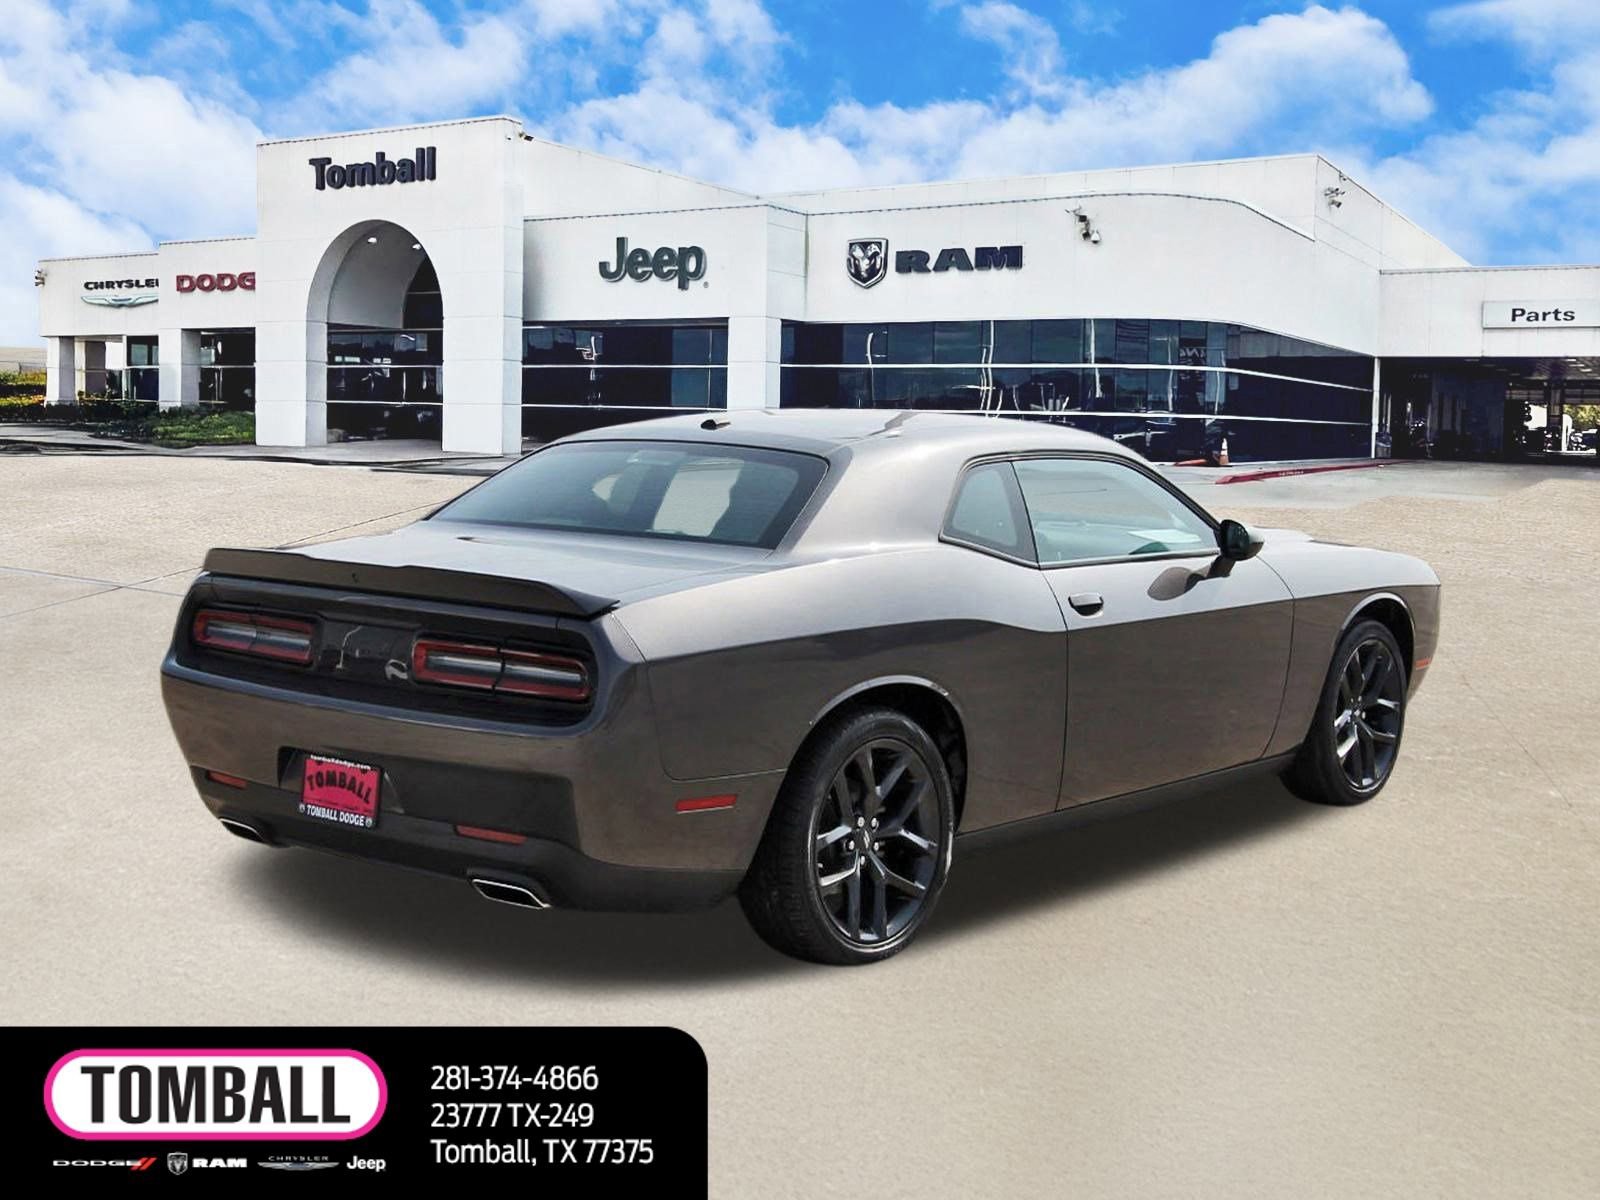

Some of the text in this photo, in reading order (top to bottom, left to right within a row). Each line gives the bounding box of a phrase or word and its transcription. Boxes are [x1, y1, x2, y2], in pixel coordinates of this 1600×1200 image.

[309, 146, 437, 190] Tomball
[599, 236, 706, 290] Jeep
[895, 245, 1024, 274] RAM
[84, 278, 160, 290] CHRYSLE
[176, 271, 256, 293] DODG
[1510, 307, 1576, 323] Parts
[307, 769, 372, 805] TOMBALL
[307, 804, 365, 827] TOMBALL DODGE
